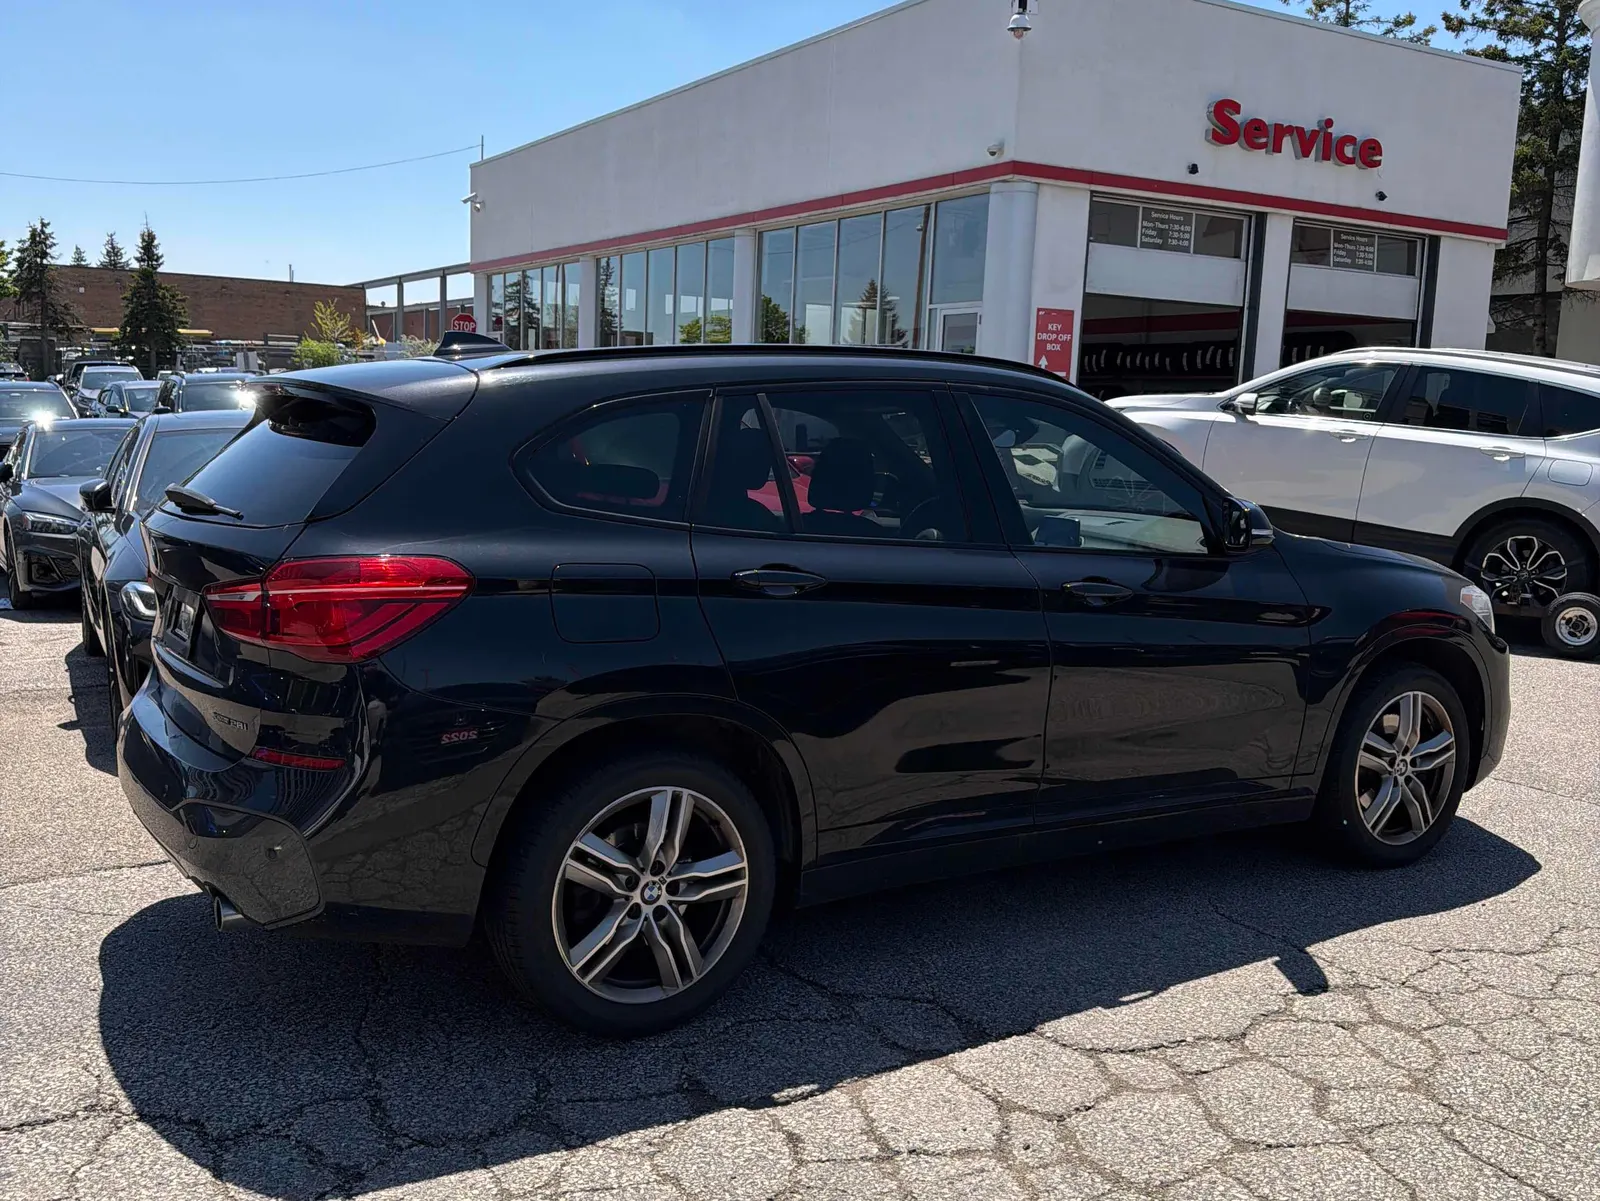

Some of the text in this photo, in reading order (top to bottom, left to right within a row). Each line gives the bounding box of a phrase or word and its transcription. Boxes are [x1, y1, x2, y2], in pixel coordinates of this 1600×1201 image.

[1206, 98, 1383, 169] Service
[1142, 228, 1156, 236] Friday
[1142, 236, 1163, 244] Saturday
[454, 321, 475, 332] STOP
